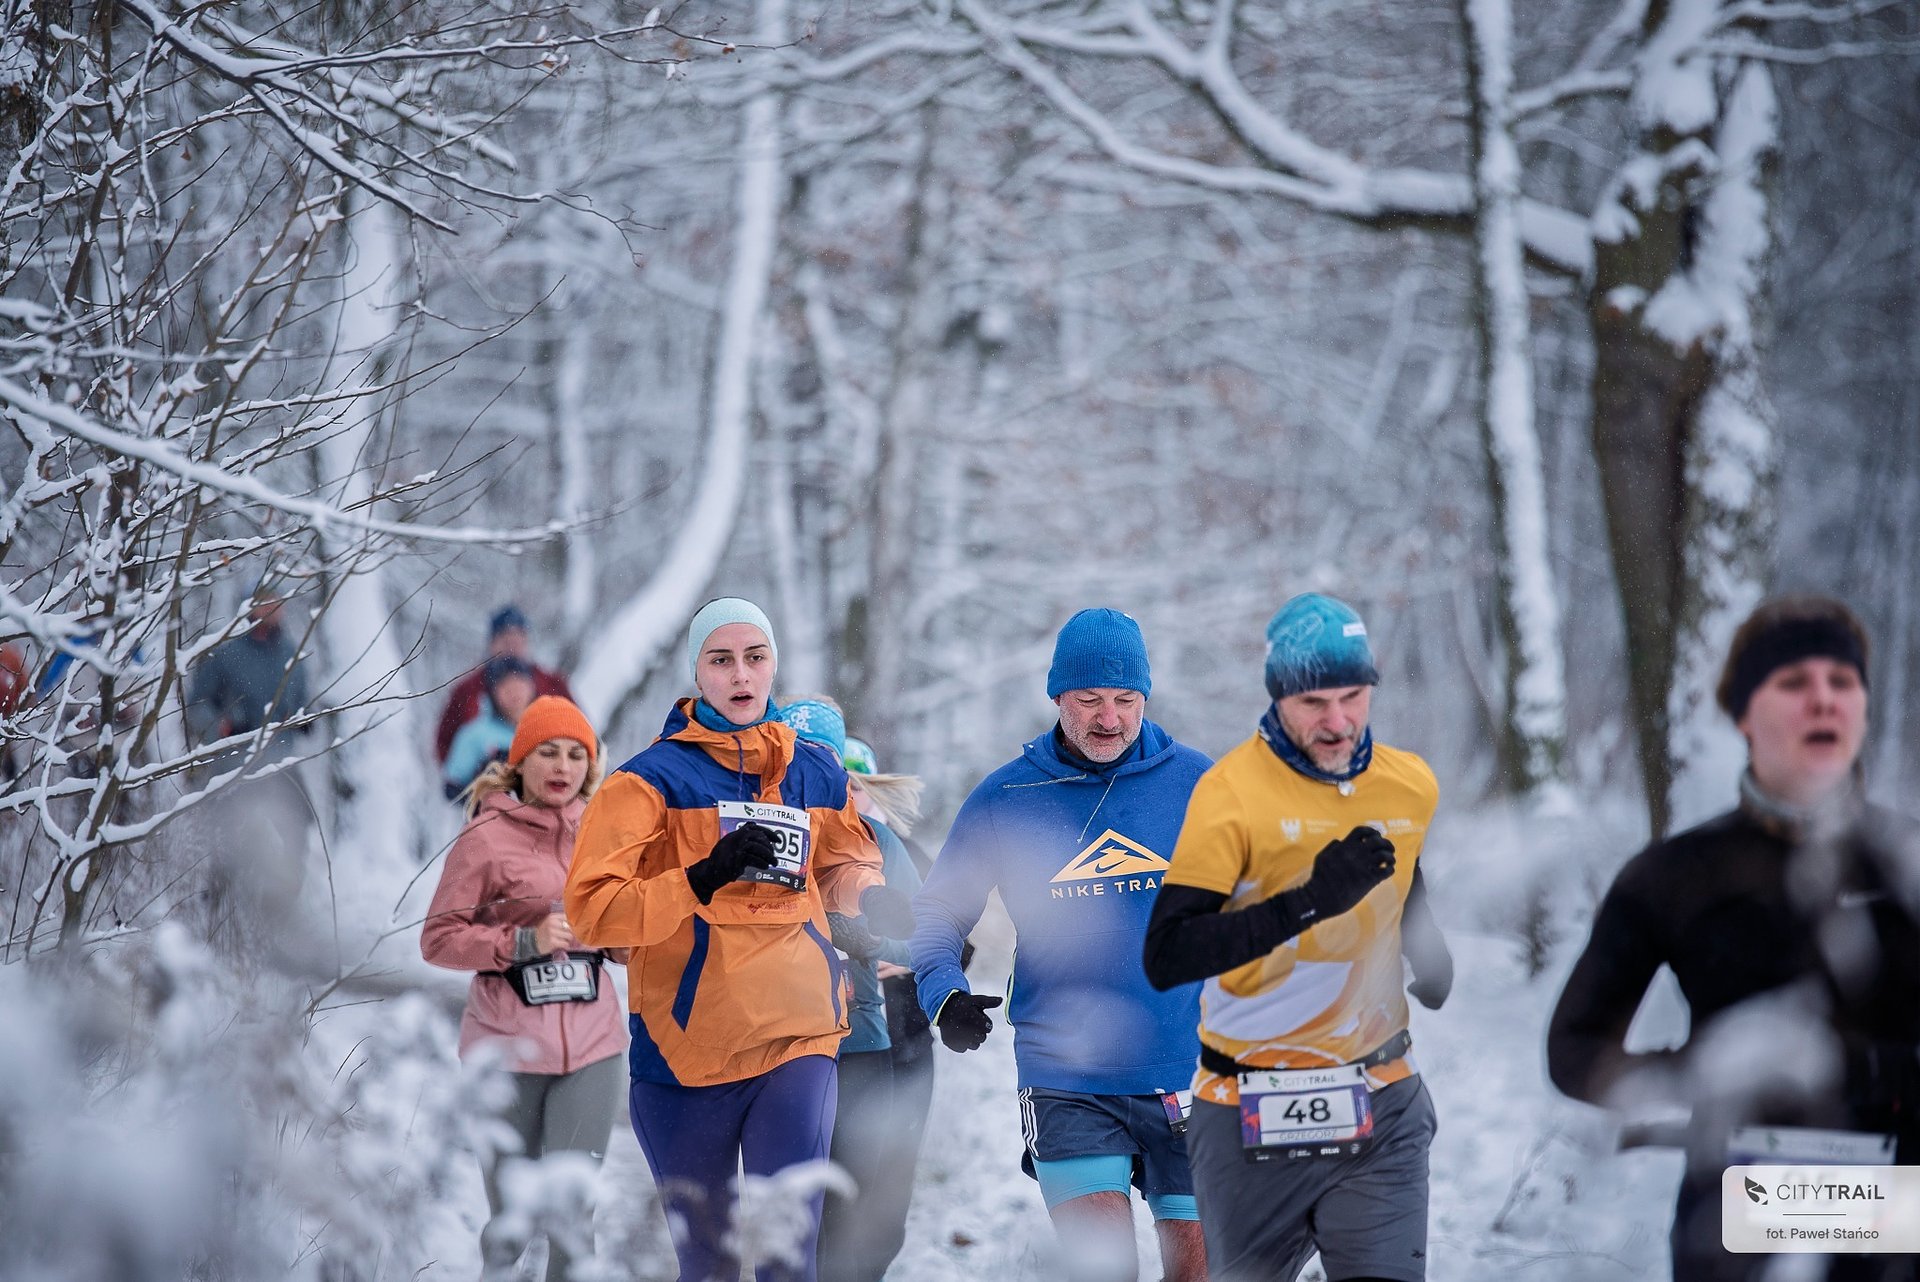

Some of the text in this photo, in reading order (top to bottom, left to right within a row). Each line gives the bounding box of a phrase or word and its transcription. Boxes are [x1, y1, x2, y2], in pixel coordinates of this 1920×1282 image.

[1051, 883, 1105, 899] NIKE
[535, 963, 575, 983] 190
[1282, 1098, 1331, 1124] 48
